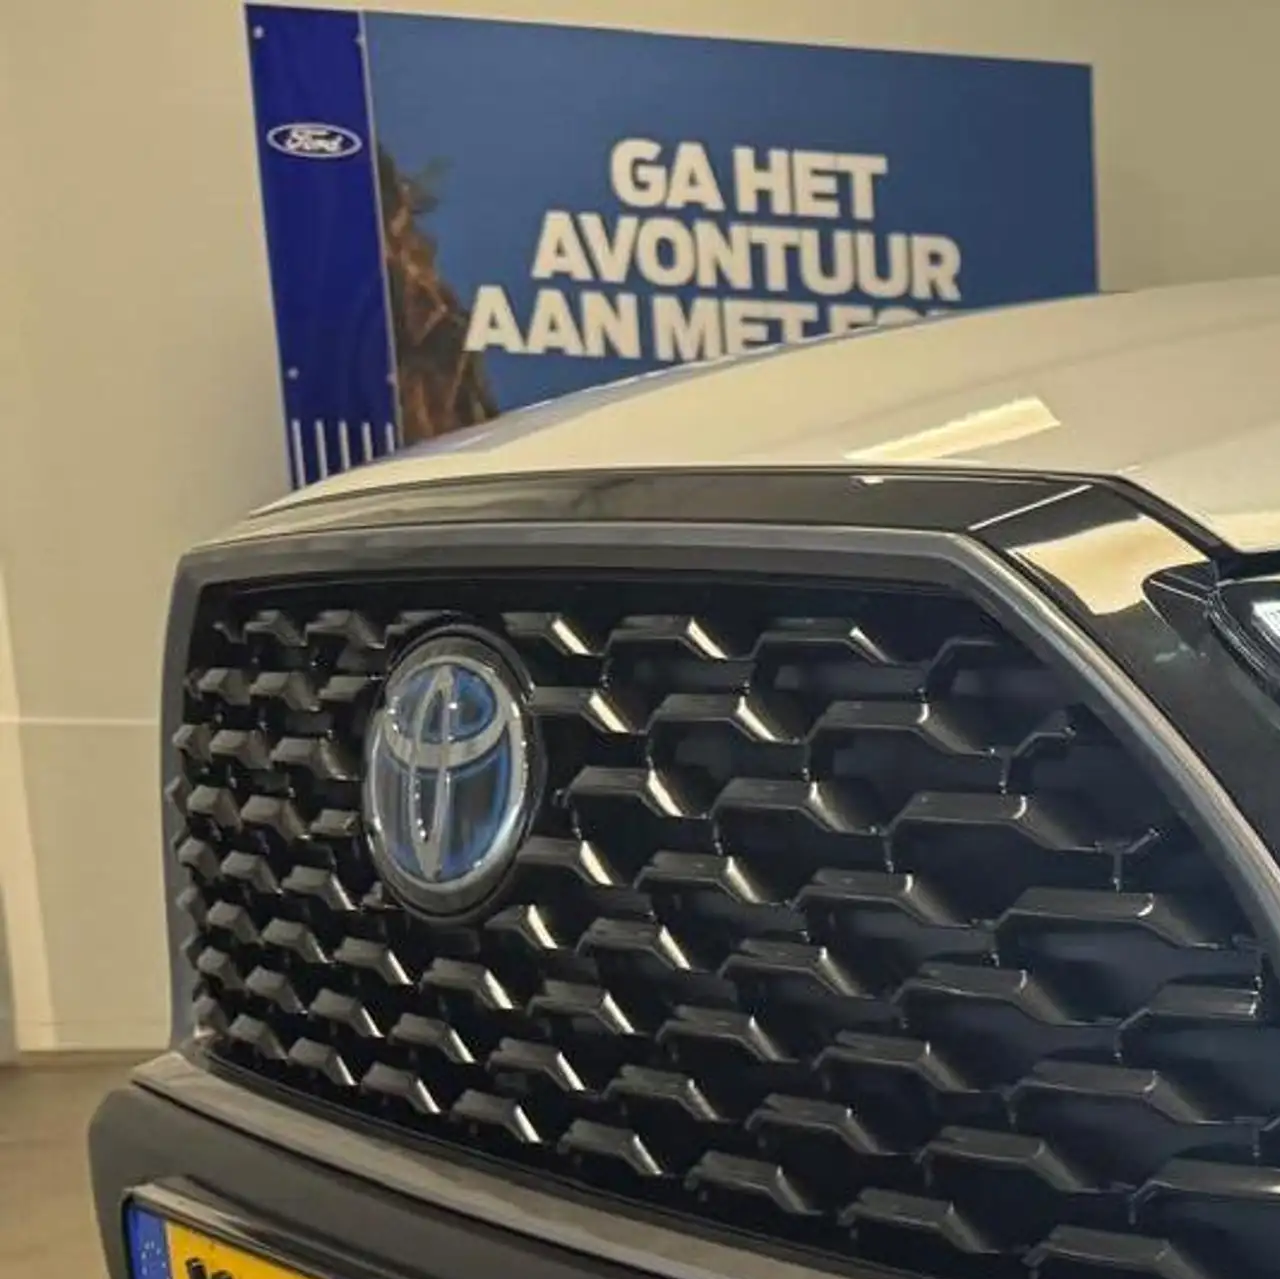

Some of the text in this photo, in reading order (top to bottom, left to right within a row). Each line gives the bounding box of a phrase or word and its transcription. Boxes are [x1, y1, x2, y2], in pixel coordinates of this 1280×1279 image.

[285, 128, 344, 153] Ford
[611, 139, 887, 220] GA HET
[532, 211, 962, 301] AVONTUUR
[465, 286, 642, 361] AAN
[653, 296, 819, 361] MET
